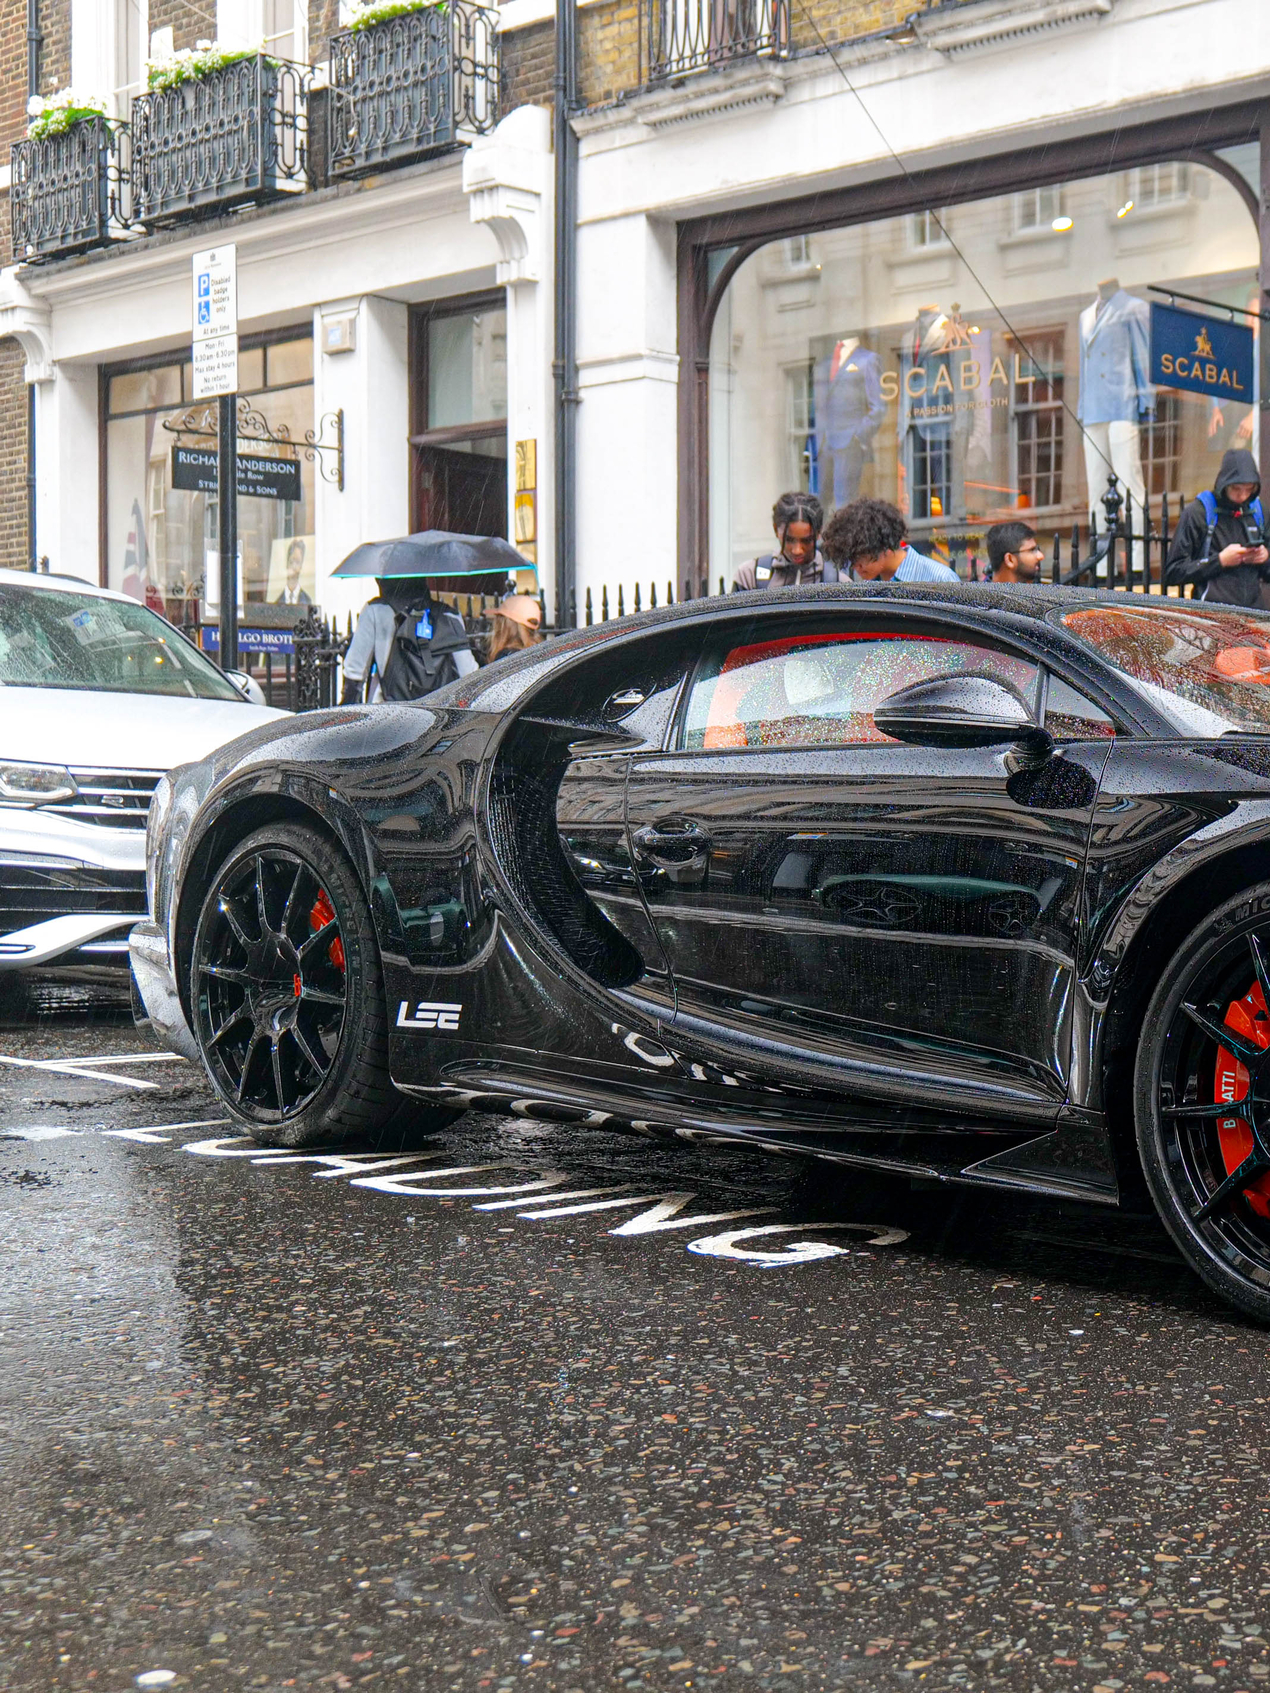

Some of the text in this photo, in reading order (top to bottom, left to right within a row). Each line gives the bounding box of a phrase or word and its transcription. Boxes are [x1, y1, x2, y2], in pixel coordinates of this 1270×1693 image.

[211, 276, 231, 287] Disabled
[214, 286, 228, 297] badge
[212, 296, 230, 306] holders
[216, 305, 226, 314] only
[210, 328, 218, 336] any
[219, 325, 230, 333] time
[195, 366, 205, 374] Max
[206, 364, 216, 373] stay
[222, 361, 235, 369] hours
[1161, 353, 1245, 389] SCABAL
[212, 374, 226, 382] return
[879, 353, 1036, 400] SCABAL
[201, 384, 215, 393] within
[219, 382, 230, 391] hour
[913, 405, 953, 417] PASSION
[956, 402, 974, 411] FOR
[976, 398, 1009, 409] CLOTH
[178, 451, 219, 466] RICHA
[247, 472, 264, 480] Row
[256, 486, 277, 496] SONS
[1221, 1071, 1236, 1129] BATTI
